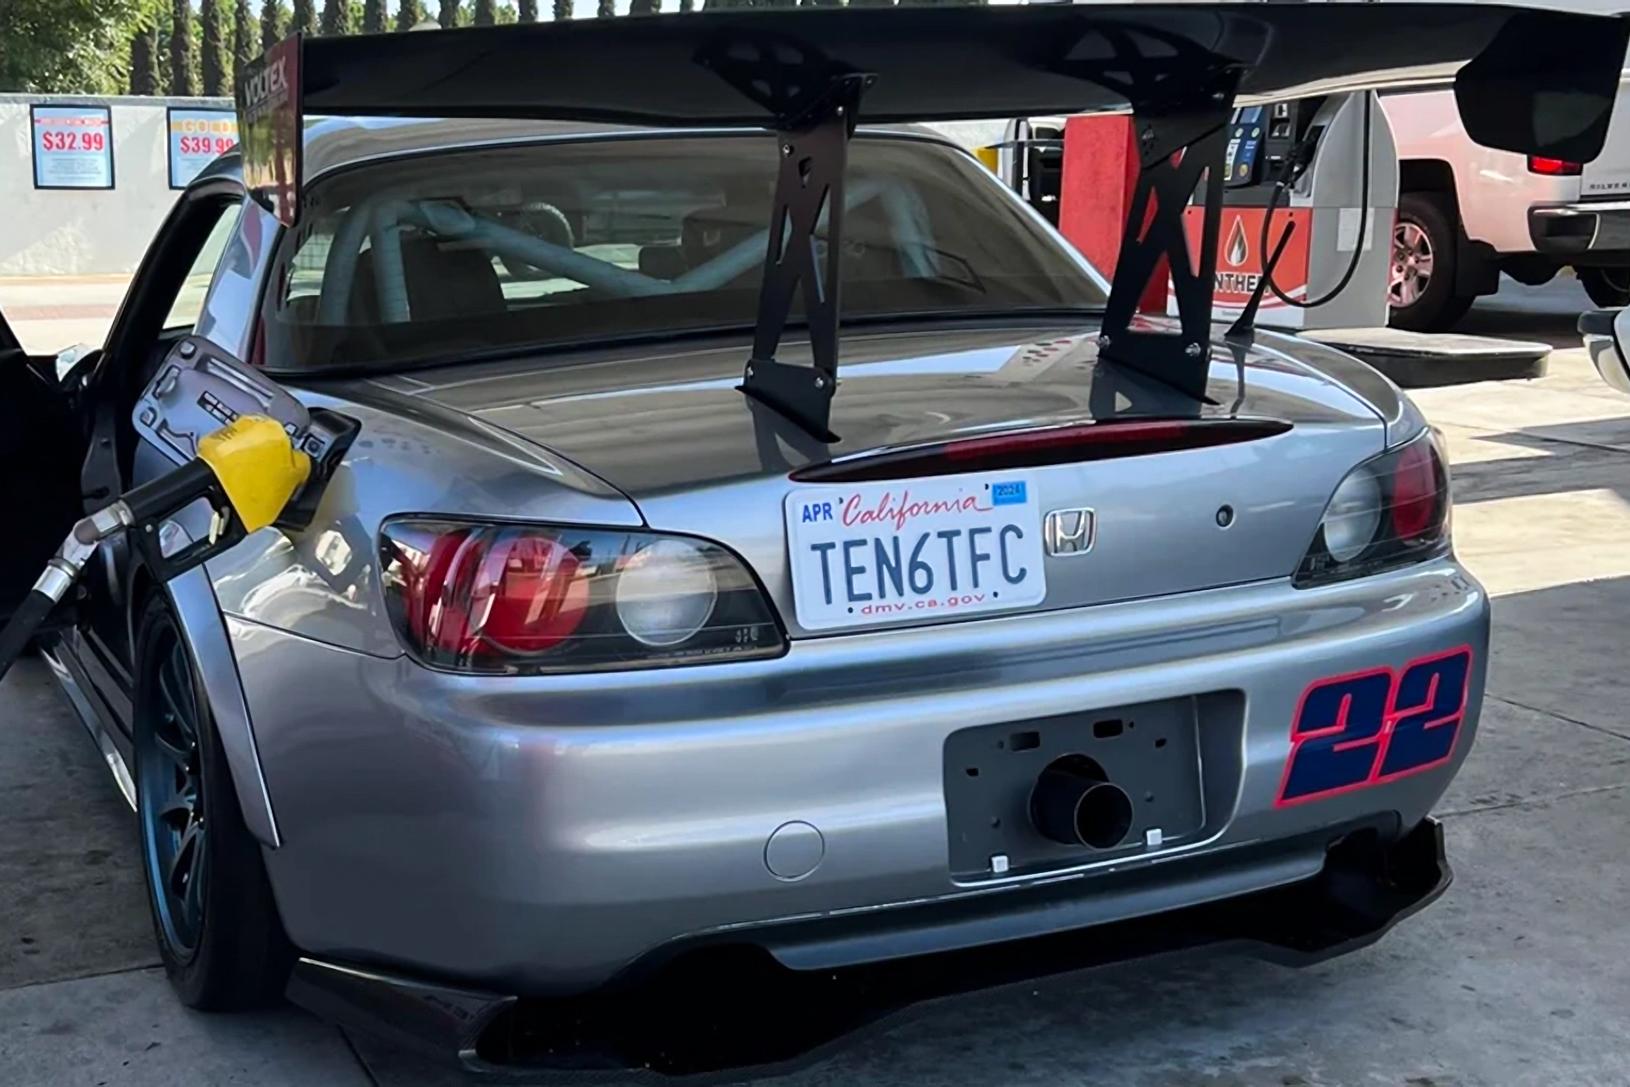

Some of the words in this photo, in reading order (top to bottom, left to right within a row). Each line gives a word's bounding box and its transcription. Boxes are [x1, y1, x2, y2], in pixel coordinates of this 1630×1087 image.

[43, 131, 104, 151] $32.99
[1590, 182, 1630, 190] SILVER
[801, 501, 833, 523] APR
[842, 490, 993, 531] California
[810, 523, 1028, 606] TEN6TFC
[860, 592, 986, 616] dmv.ca.gov
[1273, 643, 1473, 810] 22
